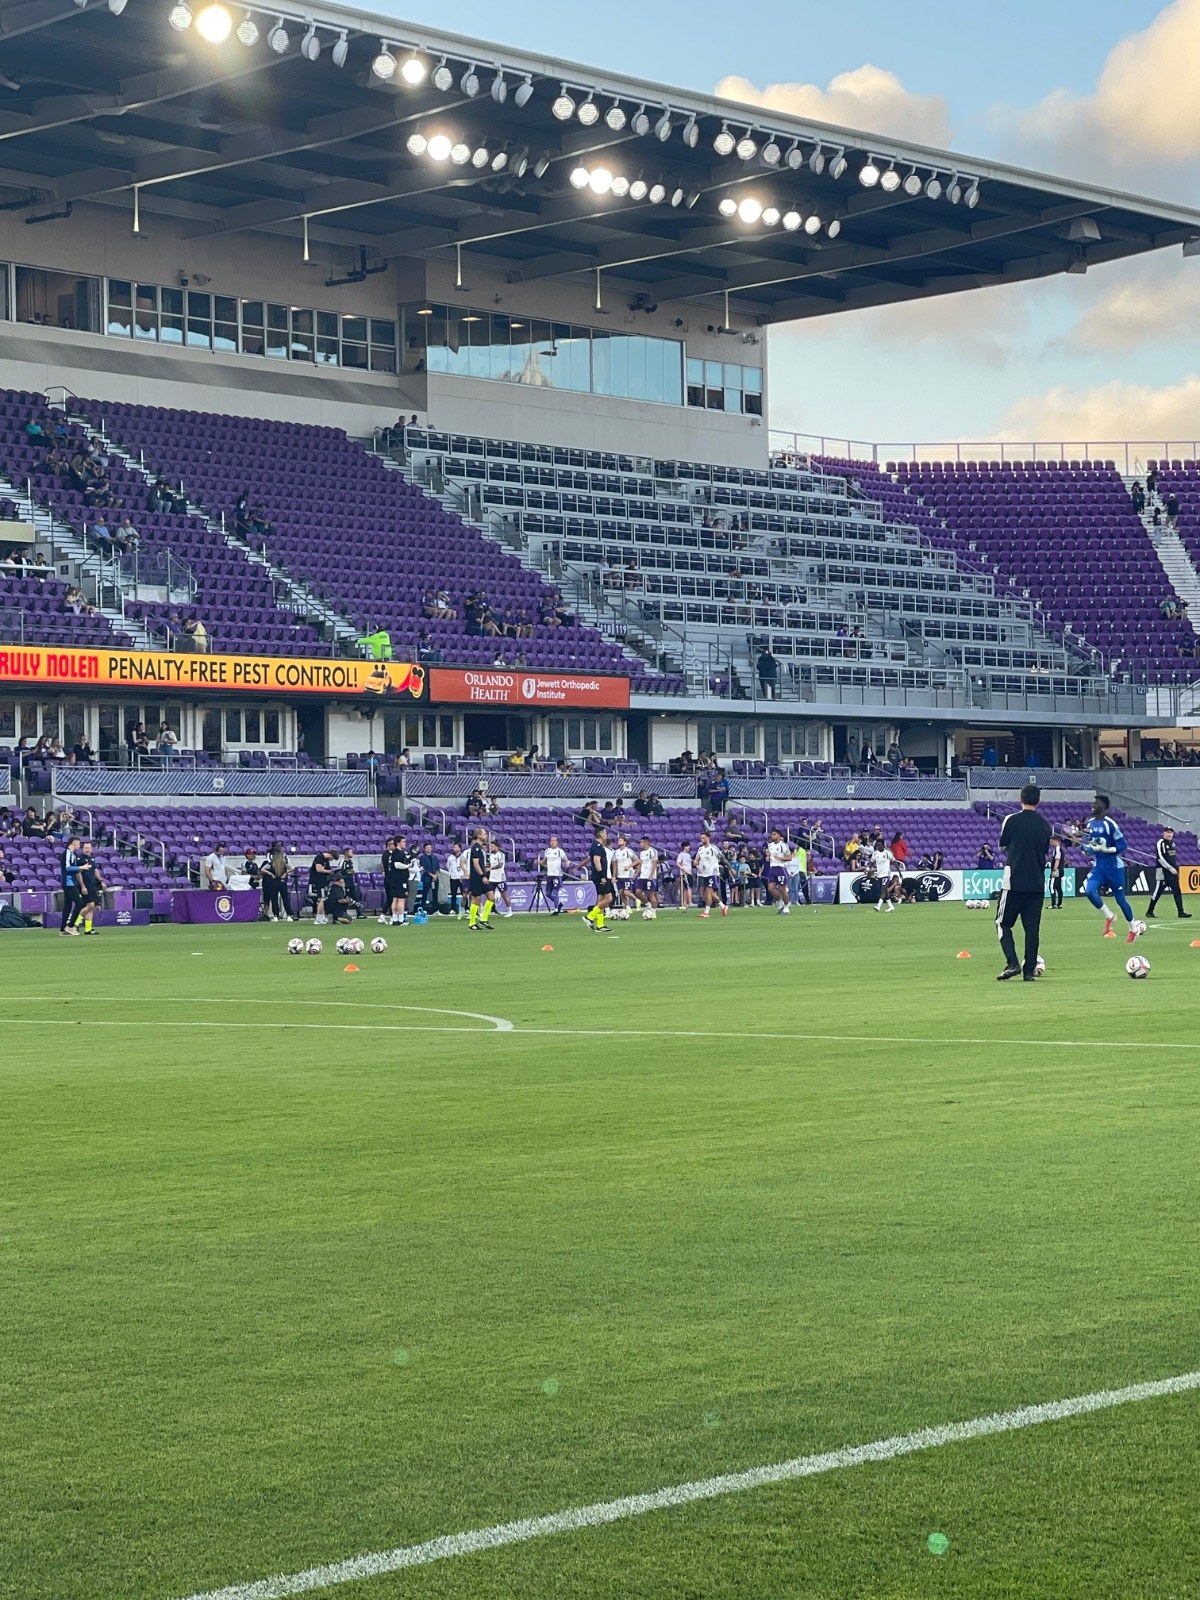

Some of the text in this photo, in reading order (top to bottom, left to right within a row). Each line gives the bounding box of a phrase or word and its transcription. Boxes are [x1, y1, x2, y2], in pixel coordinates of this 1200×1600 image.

[294, 604, 306, 615] 118
[616, 624, 627, 634] 119
[108, 657, 227, 683] PENALTY-FREE
[233, 662, 270, 685] PEST
[275, 664, 358, 688] CONTROL!
[464, 672, 514, 687] ORLANDO
[536, 679, 600, 691] Jewett Orthopedic
[470, 686, 509, 701] HEALTH
[536, 689, 566, 700] Institute
[920, 876, 945, 894] Fd
